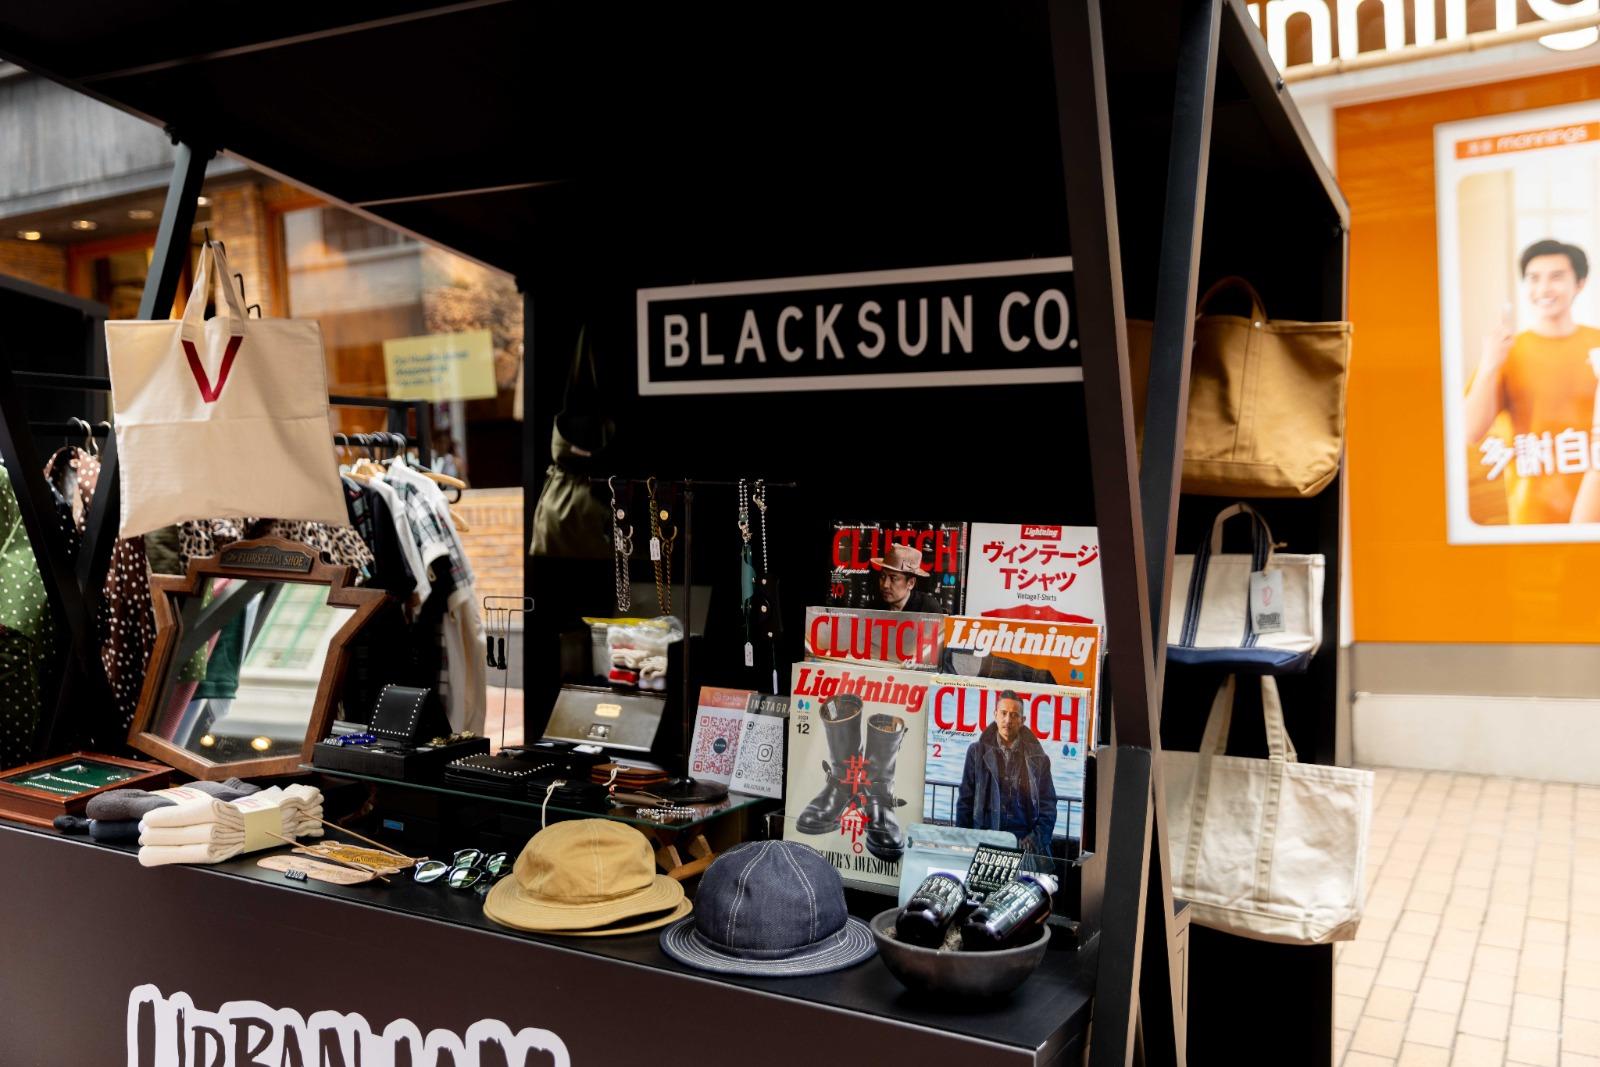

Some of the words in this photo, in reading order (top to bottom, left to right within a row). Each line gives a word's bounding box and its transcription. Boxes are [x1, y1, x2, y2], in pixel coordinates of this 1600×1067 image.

[664, 295, 974, 368] BLACKSUN
[999, 289, 1079, 352] CO.
[1479, 427, 1600, 481] 多謝自
[1024, 528, 1059, 539] Lightning
[982, 541, 1099, 567] ヴィンテージ
[999, 568, 1077, 592] Tシャツ
[810, 616, 940, 664] CLUTCH
[946, 620, 1095, 666] Lightning
[793, 668, 928, 713] Lightning
[796, 723, 810, 735] 12
[932, 743, 942, 758] 2
[853, 855, 899, 878] AWESOME!
[974, 851, 1020, 869] COLDBREW
